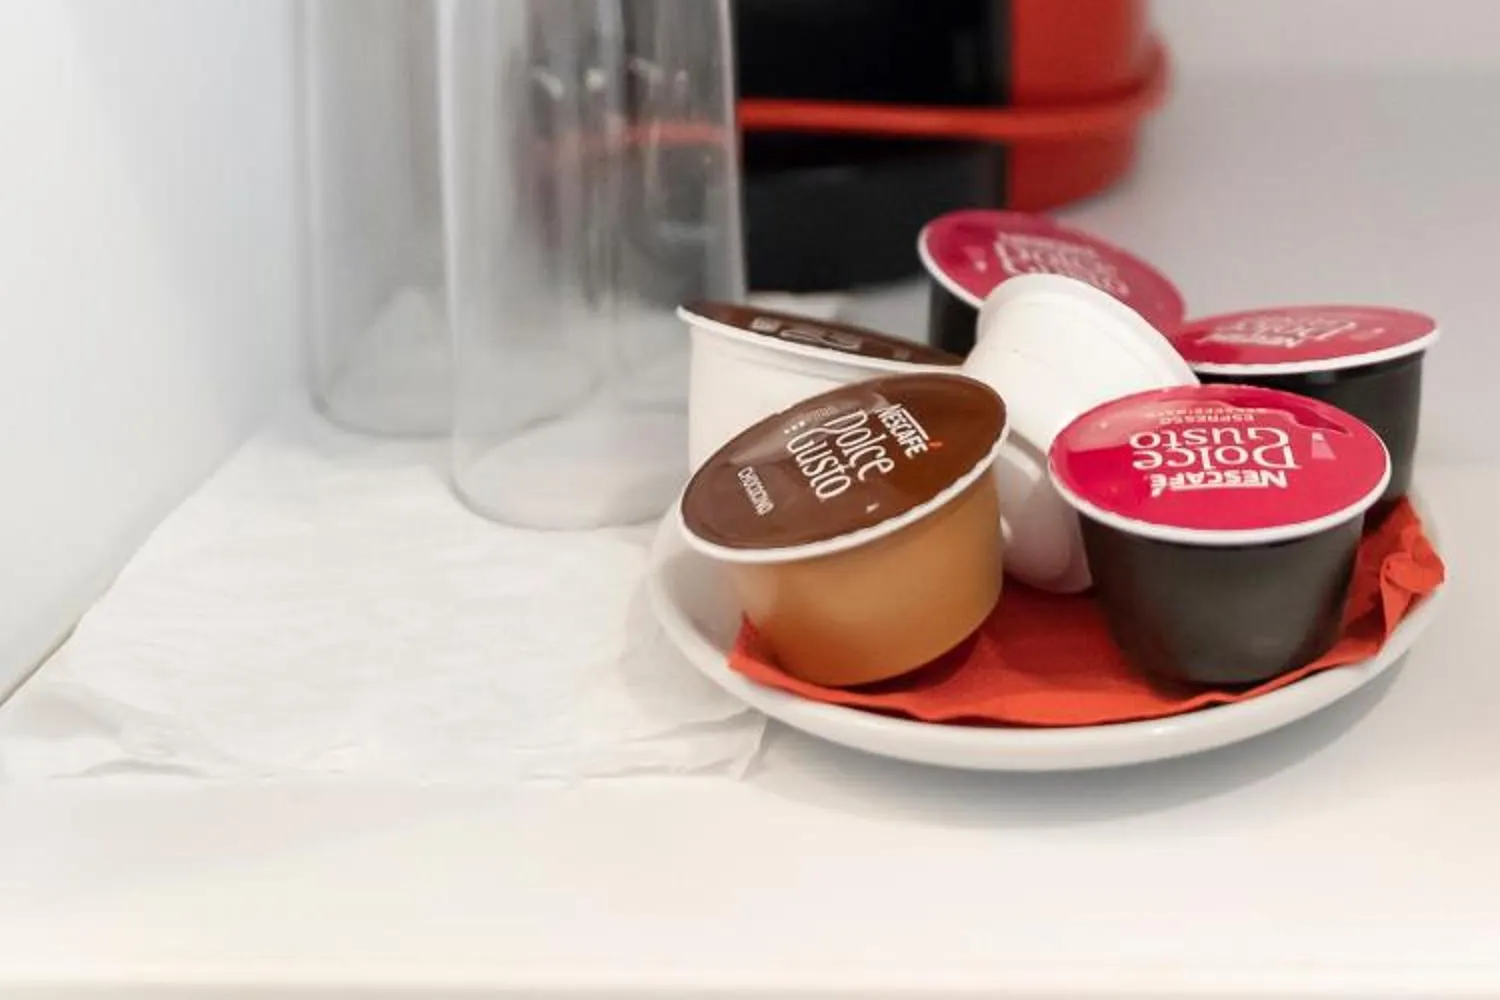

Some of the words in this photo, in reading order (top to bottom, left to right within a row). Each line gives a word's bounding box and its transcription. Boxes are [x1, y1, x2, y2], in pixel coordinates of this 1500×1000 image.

[824, 409, 895, 482] Dolce
[1129, 426, 1290, 450] Gusto
[786, 426, 851, 500] Gusto
[1131, 444, 1301, 470] Dolce
[1150, 468, 1288, 498] NESCAFÉ
